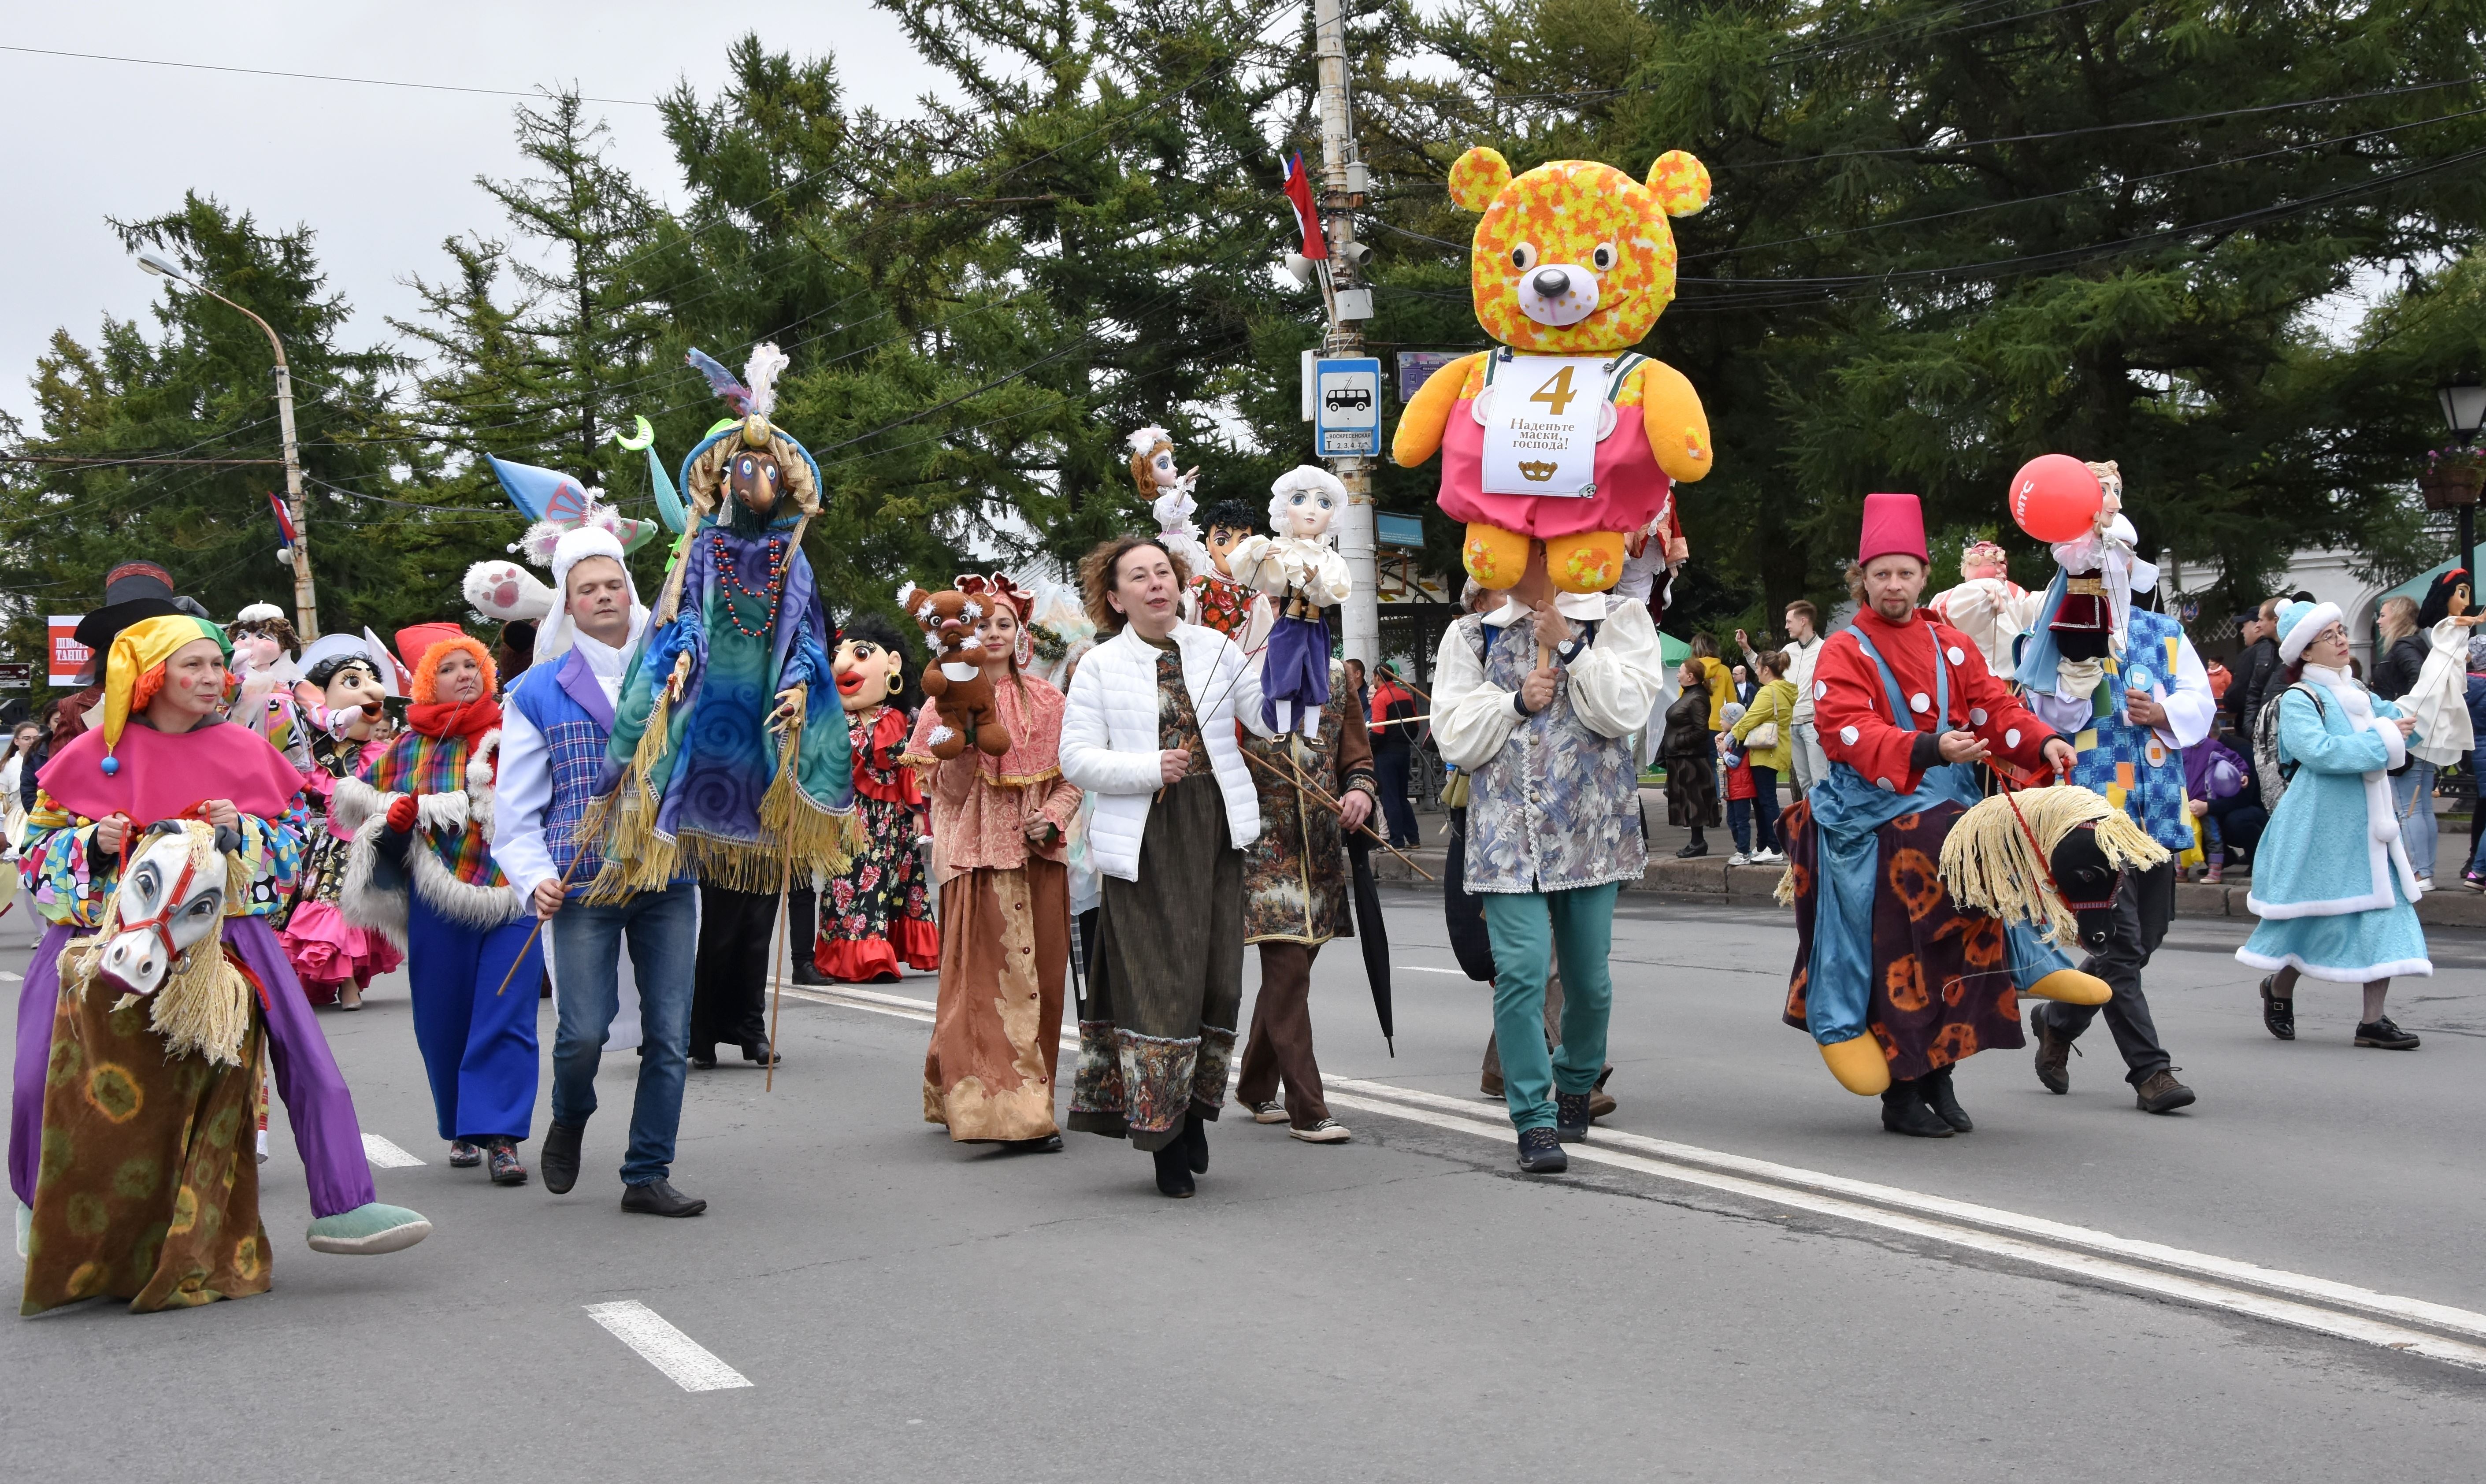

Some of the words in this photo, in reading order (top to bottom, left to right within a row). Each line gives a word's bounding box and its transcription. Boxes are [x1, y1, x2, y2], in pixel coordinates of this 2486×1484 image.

[1529, 366, 1577, 415] 4
[1510, 418, 1575, 431] Наденьте
[1519, 431, 1563, 441] маски,
[1326, 441, 1332, 449] Т
[1513, 438, 1569, 451] господа!
[2017, 480, 2034, 517] МТС
[56, 649, 89, 662] ТАНЦА
